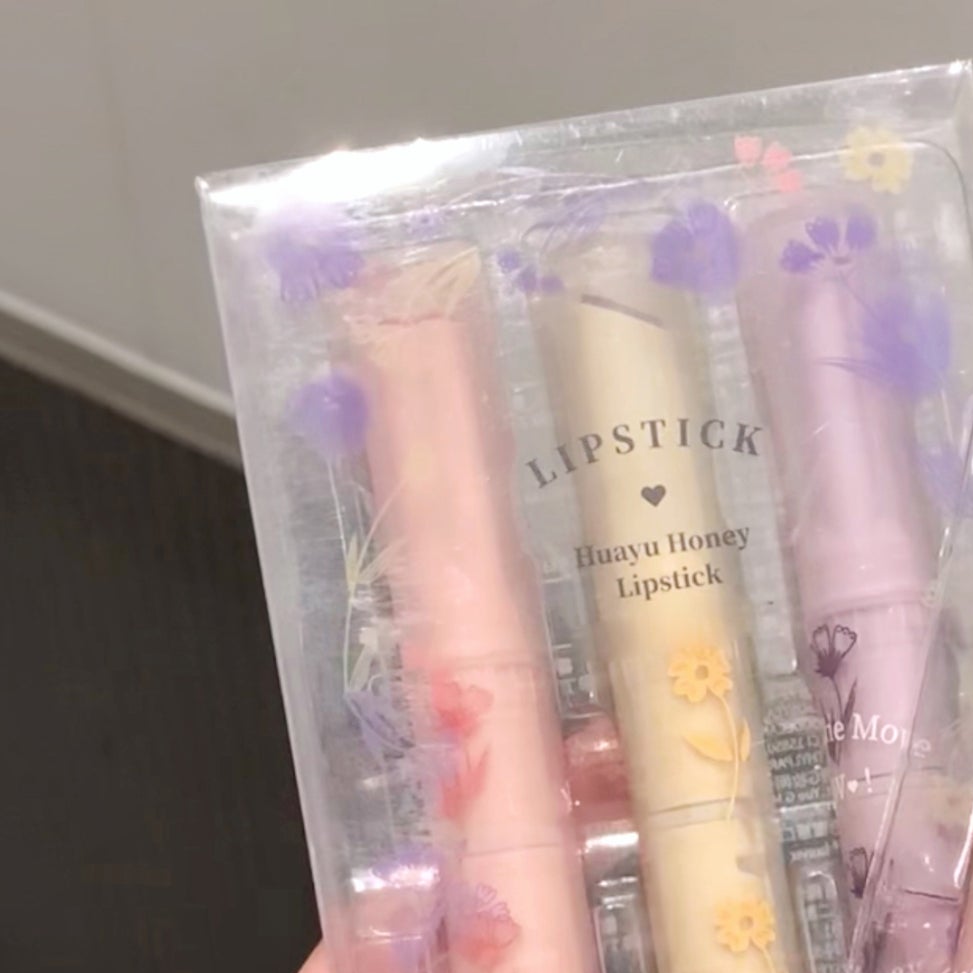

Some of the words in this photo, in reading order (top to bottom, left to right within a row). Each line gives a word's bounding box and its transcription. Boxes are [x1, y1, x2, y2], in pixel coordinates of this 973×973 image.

[525, 418, 763, 489] LIPSTICK
[574, 540, 660, 569] Huayu
[667, 526, 750, 552] Honey
[616, 563, 723, 601] Lipstick
